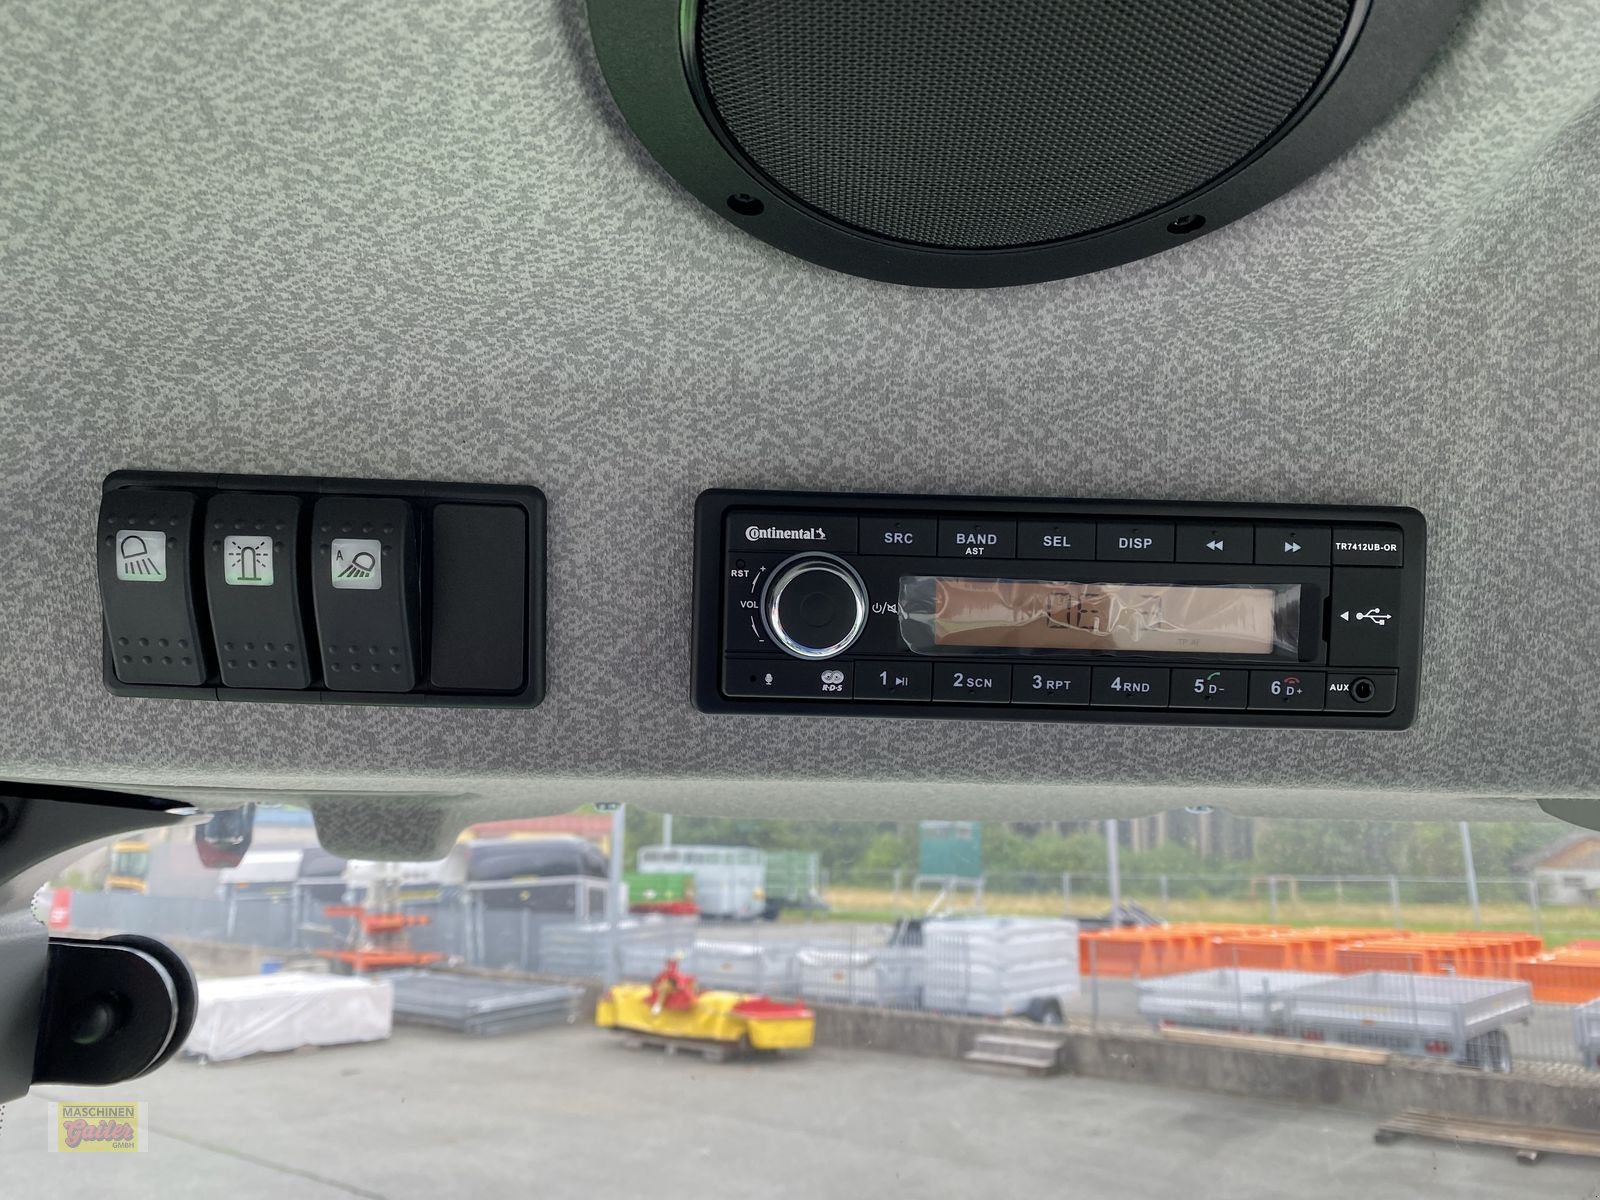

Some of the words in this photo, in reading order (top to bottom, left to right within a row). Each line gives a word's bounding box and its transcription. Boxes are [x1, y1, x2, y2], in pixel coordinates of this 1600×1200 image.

[745, 526, 815, 541] Continental
[884, 532, 914, 544] SRC
[956, 533, 998, 545] BAND
[1043, 535, 1071, 547] SEL
[1118, 537, 1153, 550] DISP
[1335, 542, 1398, 552] TR7412UB-OR
[336, 549, 344, 561] A
[965, 547, 985, 556] AST
[730, 569, 750, 578] RST
[740, 600, 759, 609] VOL
[879, 671, 888, 686] 1
[953, 673, 964, 687] 2
[966, 678, 993, 688] SCN
[1032, 675, 1042, 689] 3
[1046, 680, 1072, 690] RPT
[1110, 677, 1121, 691] 4
[1123, 682, 1150, 693] RND
[1194, 679, 1205, 693] 5
[1271, 680, 1281, 695] 6
[1329, 684, 1350, 692] AUX
